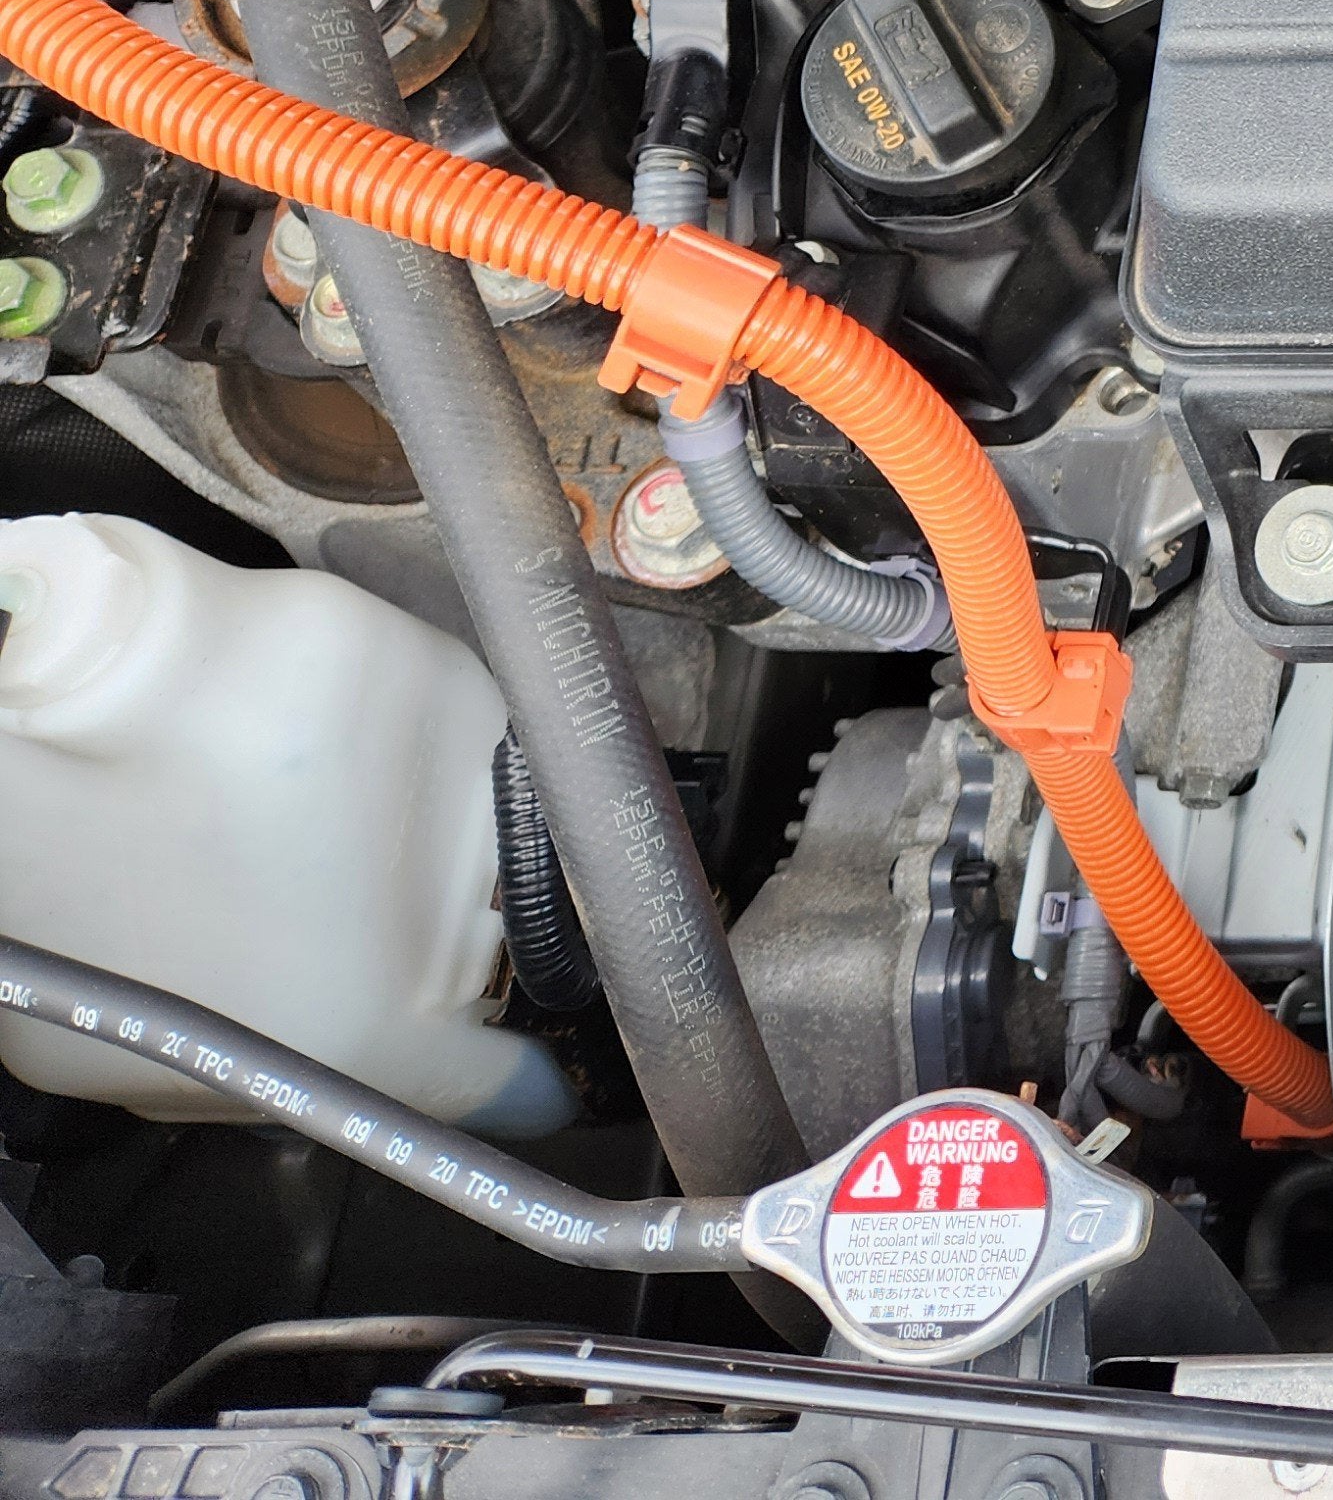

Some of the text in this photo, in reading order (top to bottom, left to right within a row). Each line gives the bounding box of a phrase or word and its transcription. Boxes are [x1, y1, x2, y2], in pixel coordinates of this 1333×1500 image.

[831, 40, 906, 151] SAE 0W-20
[629, 785, 667, 852] 15LP
[907, 1118, 1002, 1143] DANGER
[193, 1044, 235, 1082] TPC
[384, 1136, 414, 1167] 09
[428, 1155, 461, 1186] 20
[462, 1169, 512, 1211] TPC
[511, 1196, 610, 1246] >EPDM<
[906, 1140, 1019, 1166] WARNUNG
[850, 1213, 1023, 1232] NEVER OPEN WHEN HOT.
[848, 1231, 1006, 1249] Hot coolant will scald you.
[832, 1248, 1030, 1267] N'OUVREZ PAS QUAND CHAUD.
[834, 1269, 869, 1285] NICHT
[869, 1269, 887, 1284] BEI
[888, 1268, 935, 1283] HEISSEM
[936, 1267, 976, 1282] MOTOR
[896, 1322, 944, 1339] 108kPa
